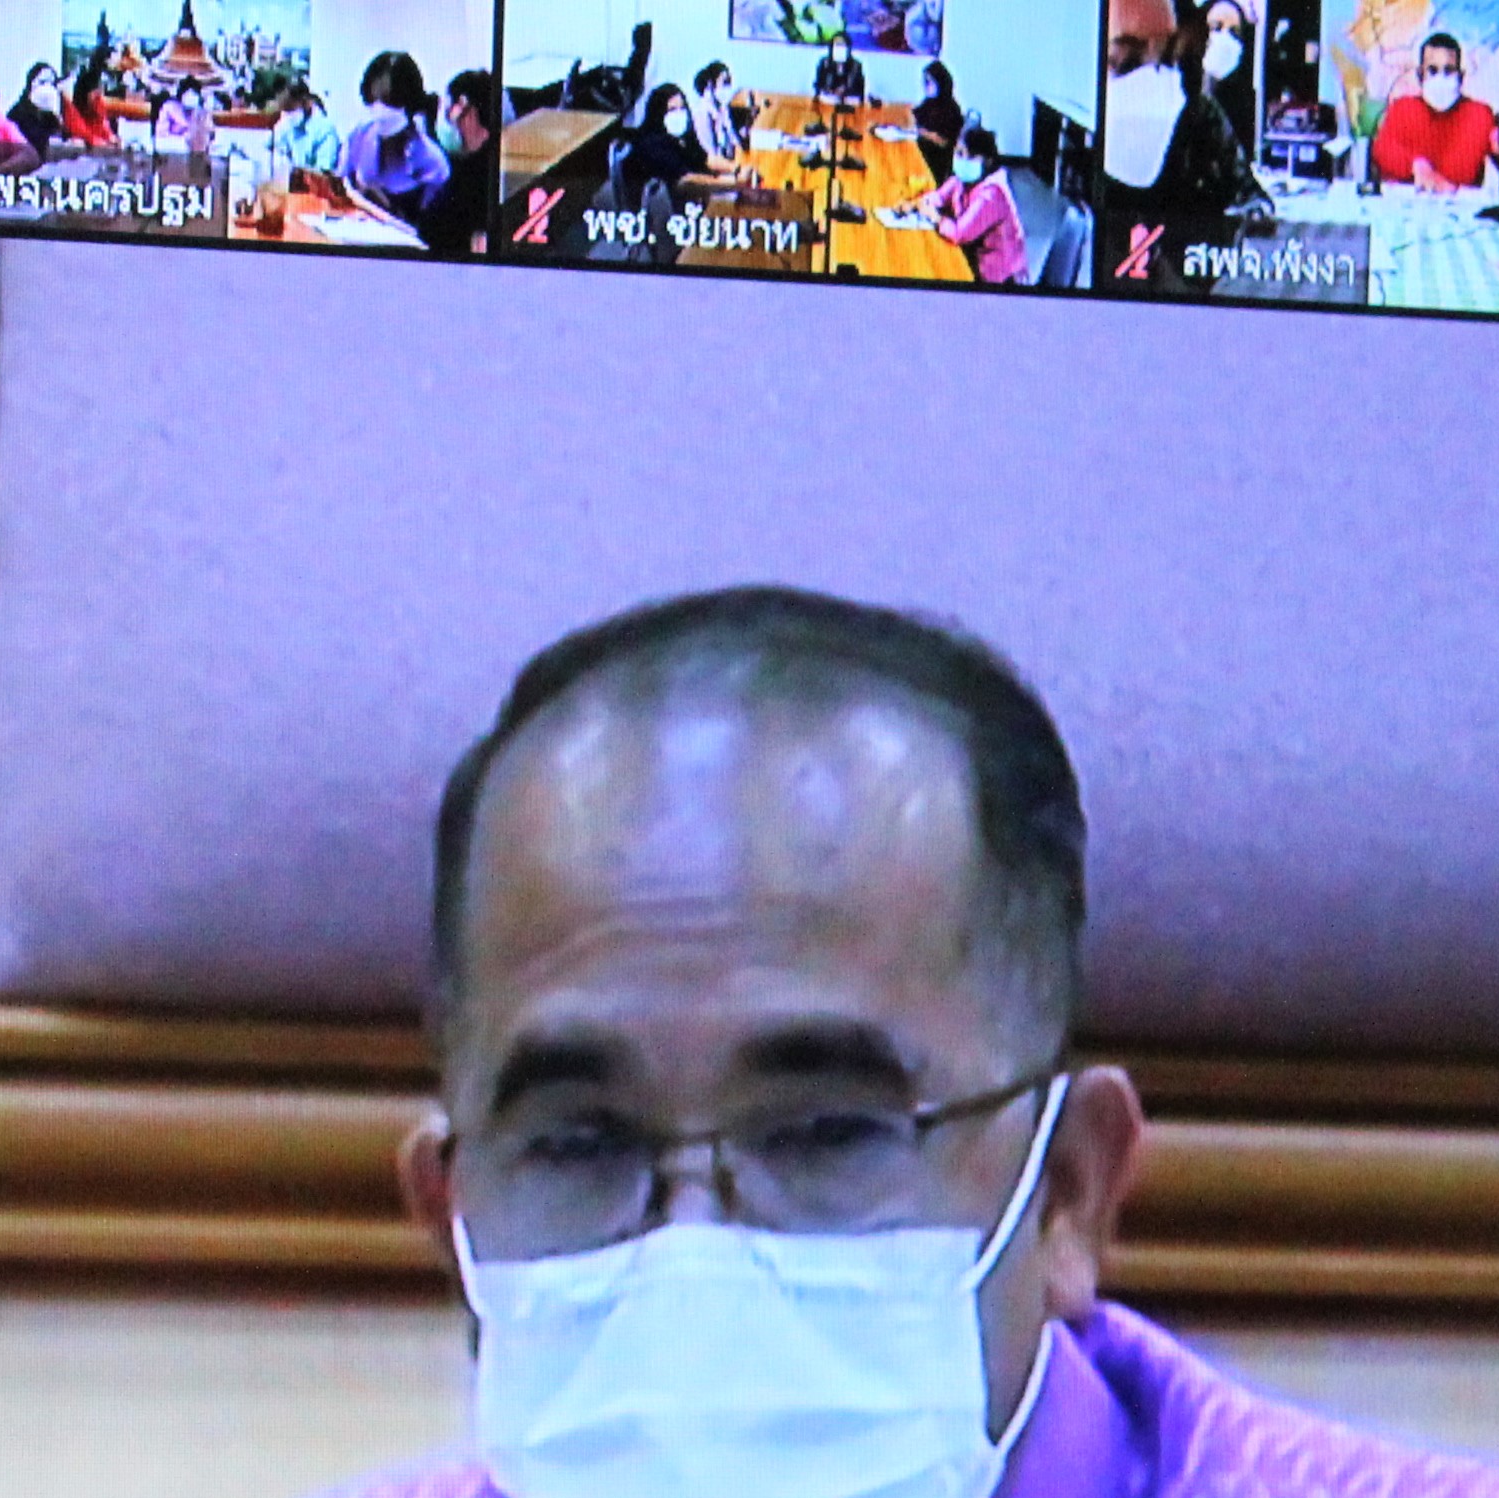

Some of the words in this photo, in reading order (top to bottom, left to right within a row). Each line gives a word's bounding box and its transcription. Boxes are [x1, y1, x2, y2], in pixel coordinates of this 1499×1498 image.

[582, 208, 657, 245] พช.
[666, 201, 798, 253] ชัยนาท
[1183, 237, 1355, 287] สพจ.พังงา
